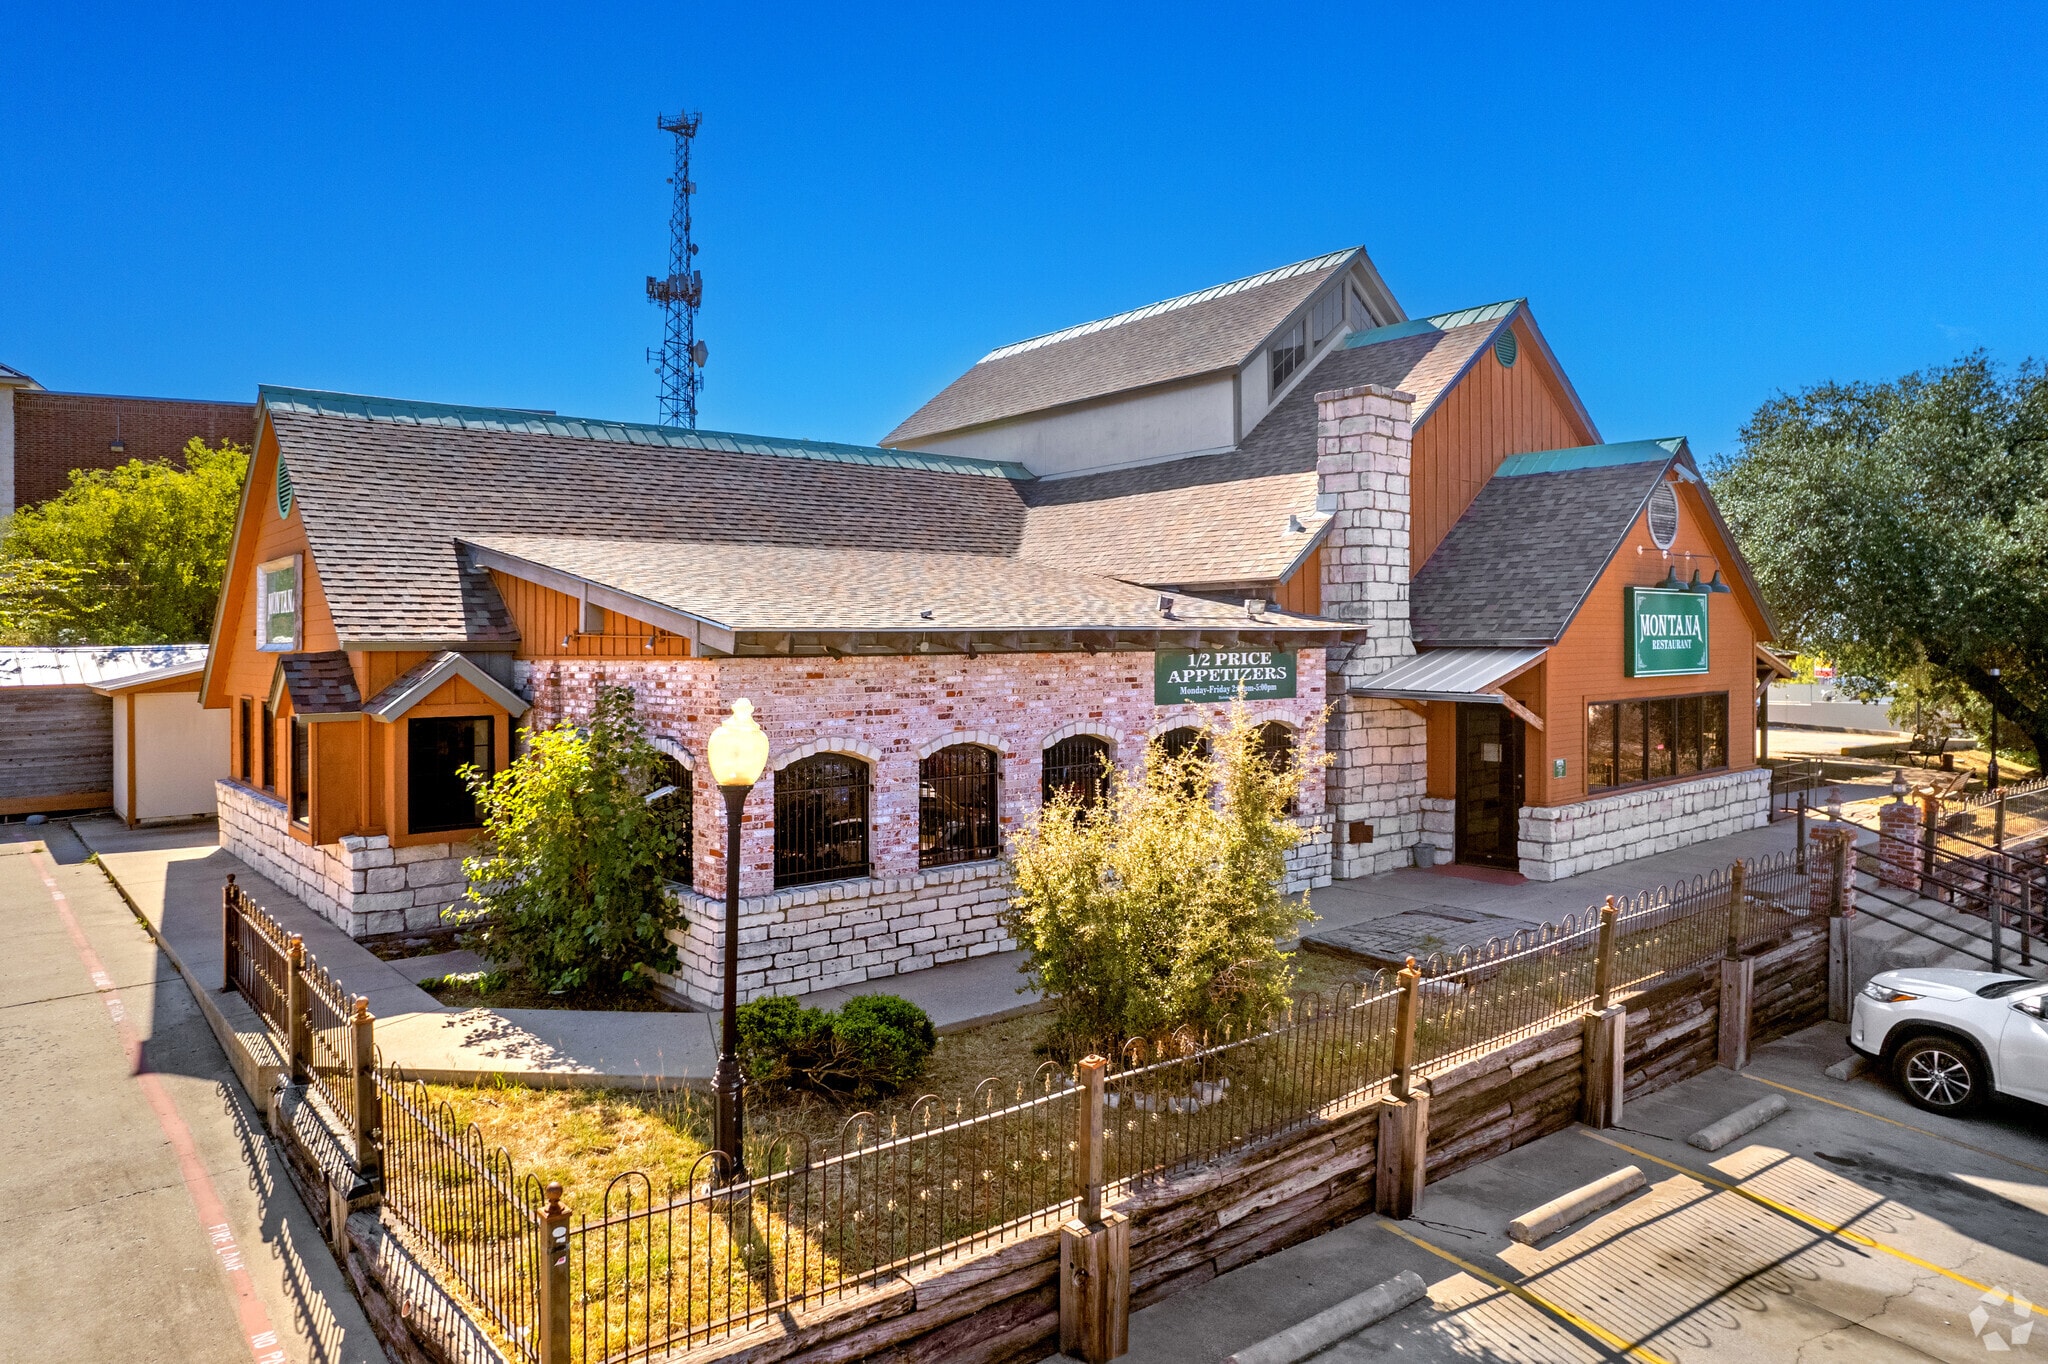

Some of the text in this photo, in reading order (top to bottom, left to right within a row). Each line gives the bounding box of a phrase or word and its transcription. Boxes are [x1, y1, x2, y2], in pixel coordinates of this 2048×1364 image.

[1639, 614, 1704, 644] MONTANA
[1652, 639, 1692, 650] RESTAURANT
[1188, 651, 1272, 668] 1/2 PRICE
[1167, 666, 1287, 684] APPETIZERS
[1180, 684, 1233, 696] Monday-Friday
[208, 1223, 234, 1245] FIRE
[251, 1330, 278, 1349] NO
